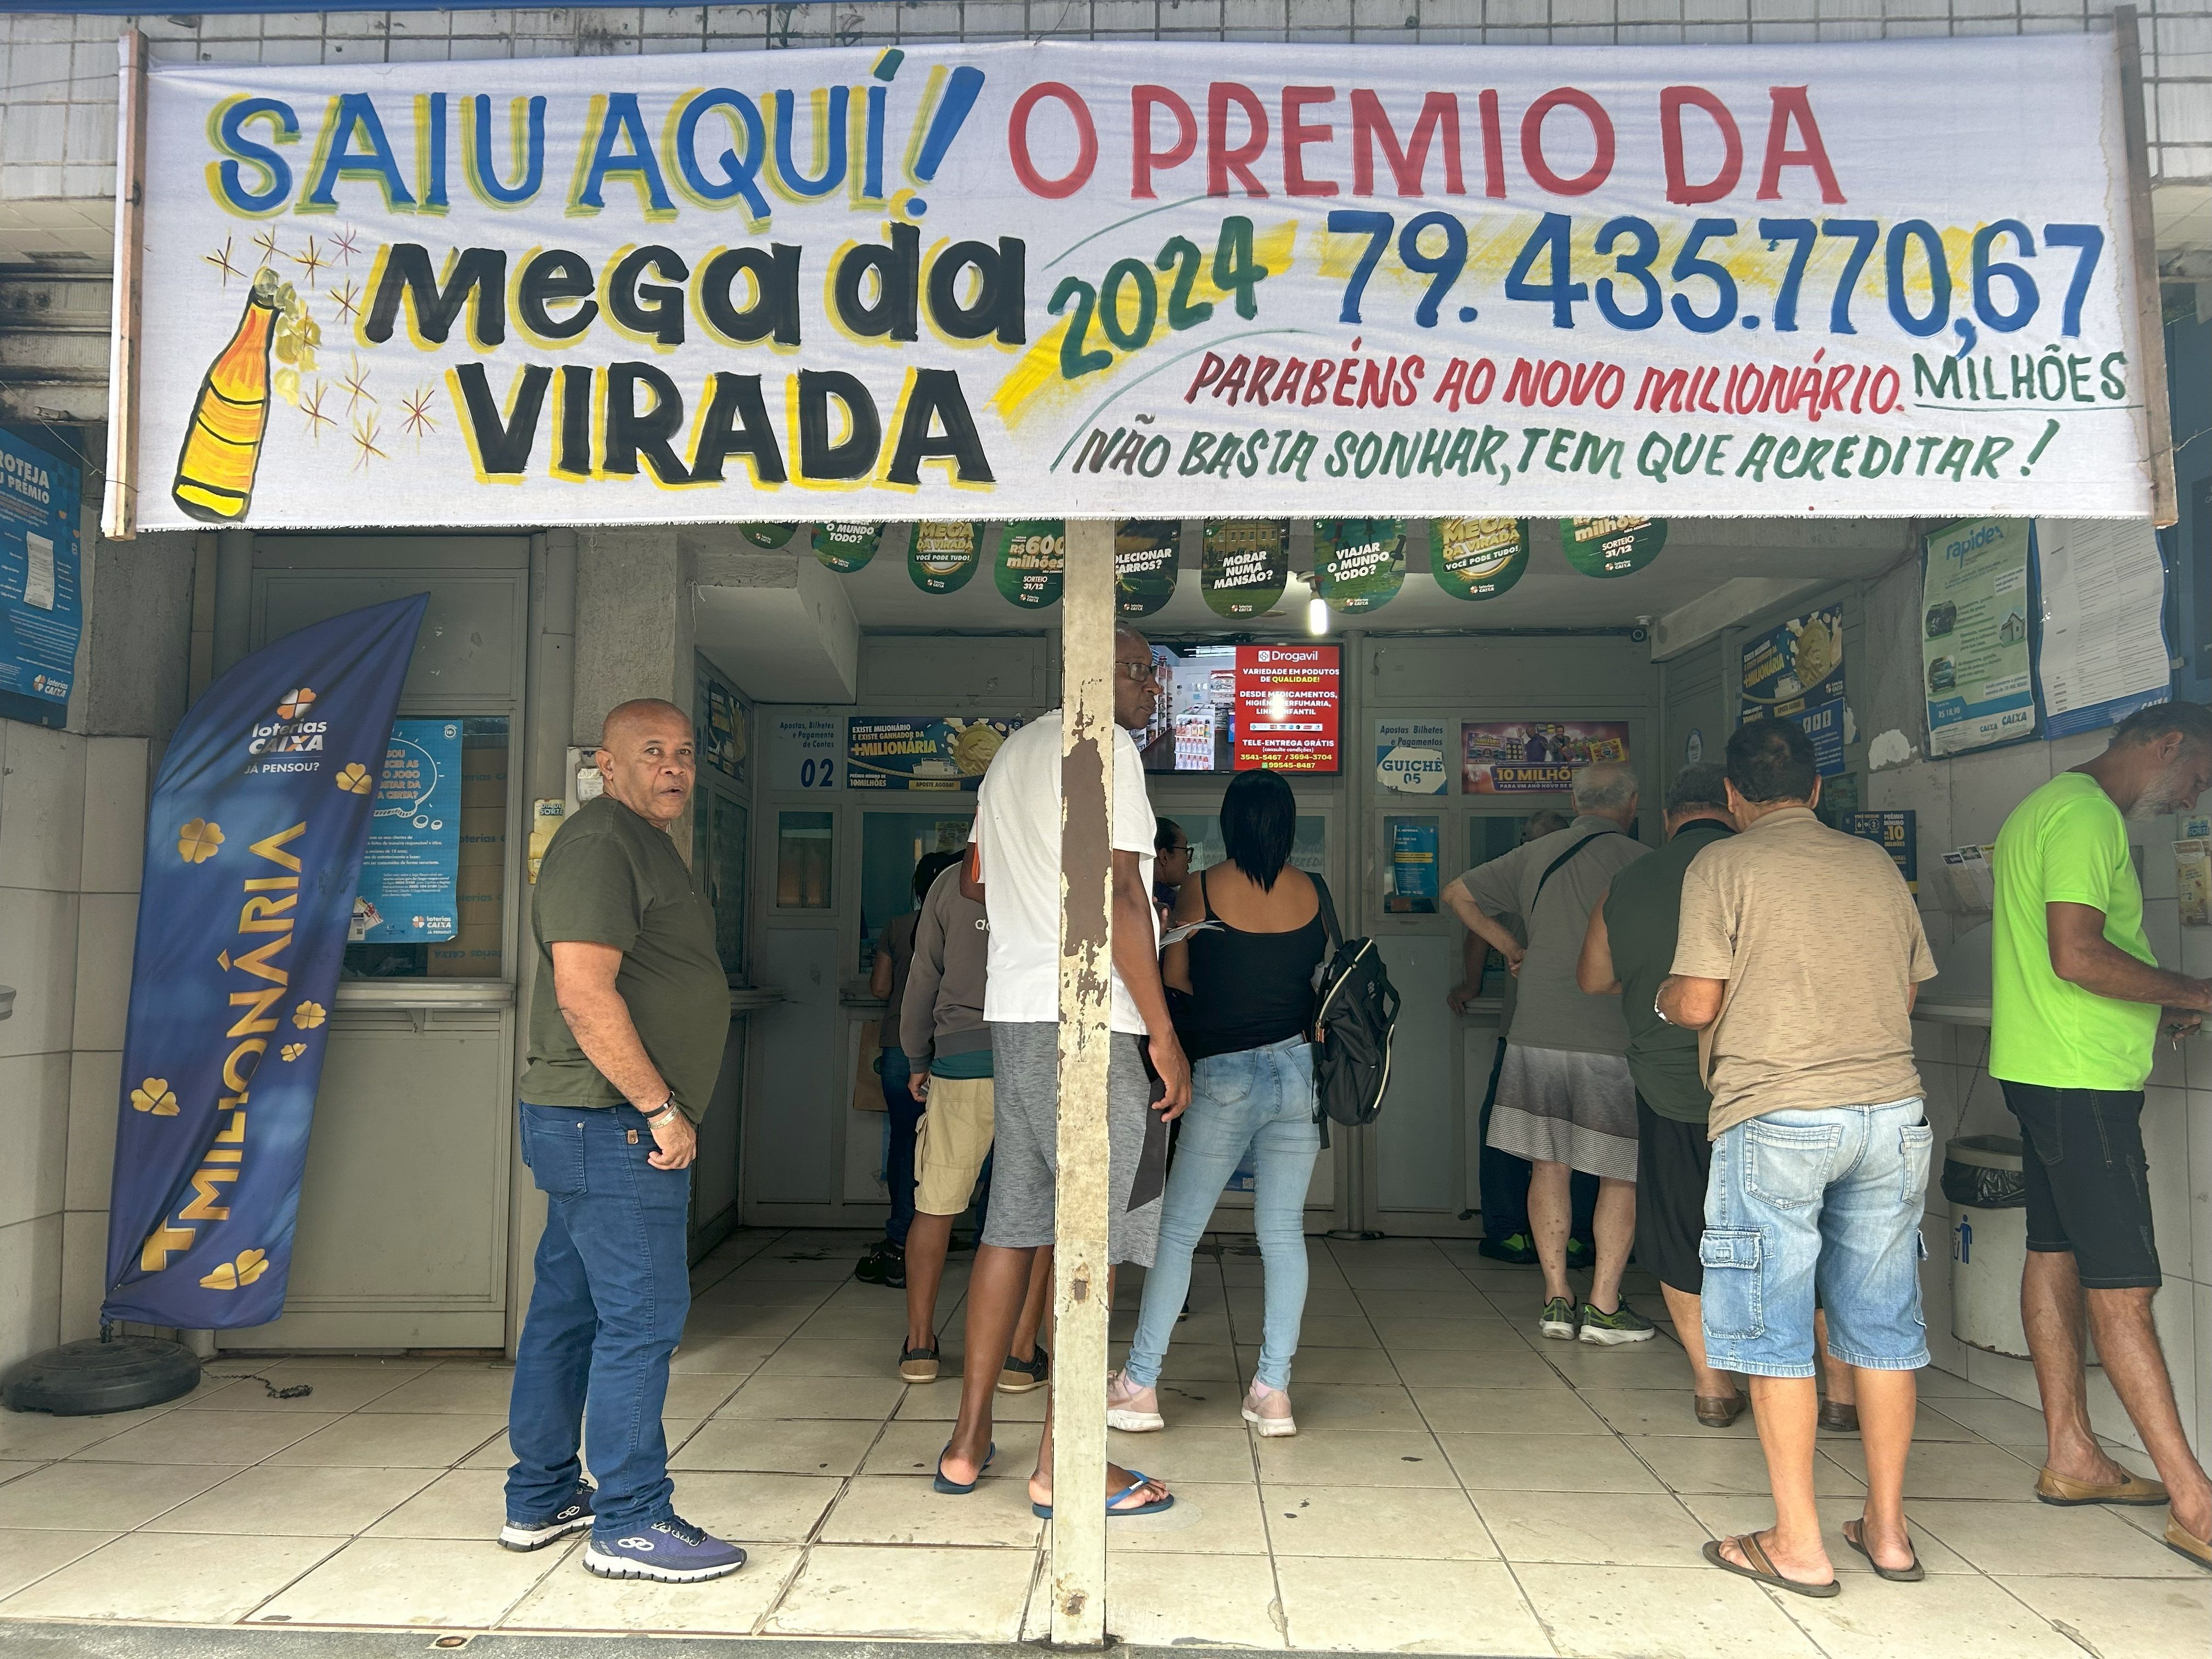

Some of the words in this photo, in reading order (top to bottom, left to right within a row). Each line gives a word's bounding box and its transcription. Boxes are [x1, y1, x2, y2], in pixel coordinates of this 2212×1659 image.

[208, 90, 548, 216] SAIU
[1008, 81, 1098, 199] O
[1130, 81, 1615, 200] PREMIO
[1660, 84, 1847, 207] DA
[1047, 216, 1269, 380] 2024
[1184, 336, 1425, 409] PARABÉNS
[1433, 357, 1496, 412] AO
[1502, 358, 1626, 411] NOVO
[449, 360, 996, 489] VIRADA
[1072, 413, 1171, 476] NÃO
[1177, 427, 1312, 480] BASTA
[1637, 430, 1735, 483] QUE
[1735, 432, 2016, 483] ACREDITAR
[826, 523, 835, 531] O
[837, 524, 874, 535] MUNDO
[919, 521, 974, 539] MEGA
[830, 532, 863, 544] TODO?
[934, 540, 973, 550] VIRADA
[1466, 529, 1520, 553] VIRADA
[1601, 535, 1635, 551] SORTEIO
[1335, 542, 1380, 560] VIAJAR
[1446, 559, 1467, 571] VOCÊ
[1469, 554, 1491, 565] PODE
[1493, 545, 1519, 558] TUDO!
[1605, 545, 1632, 558] 31/12
[1223, 551, 1267, 567] MORAR
[1327, 562, 1337, 573] O
[1340, 551, 1389, 571] MUNDO
[1226, 562, 1262, 577] NUMA
[1334, 564, 1376, 582] TODO?
[1272, 651, 1318, 662] Drogavil
[780, 722, 806, 730] Apostas,
[2002, 712, 2027, 726] CAIXA
[252, 718, 327, 738] loterias
[873, 723, 911, 733] MILIONÁRIO
[1380, 725, 1409, 735] Apostas
[1413, 725, 1443, 733] Bilhetes
[1979, 723, 1998, 732] CAIXA
[798, 731, 834, 741] Pagamento
[879, 731, 914, 740] GANHADOR
[1304, 738, 1334, 747] GRÁTIS
[1397, 737, 1442, 747] Pagamentos
[249, 735, 323, 755] CAIXA
[245, 762, 258, 774] JÁ
[262, 761, 320, 774] PENSOU?
[1382, 757, 1443, 772] GUICHÊ
[800, 758, 834, 788] 02
[1403, 773, 1421, 785] 05
[1496, 768, 1514, 781] 10
[1888, 826, 1905, 840] 10
